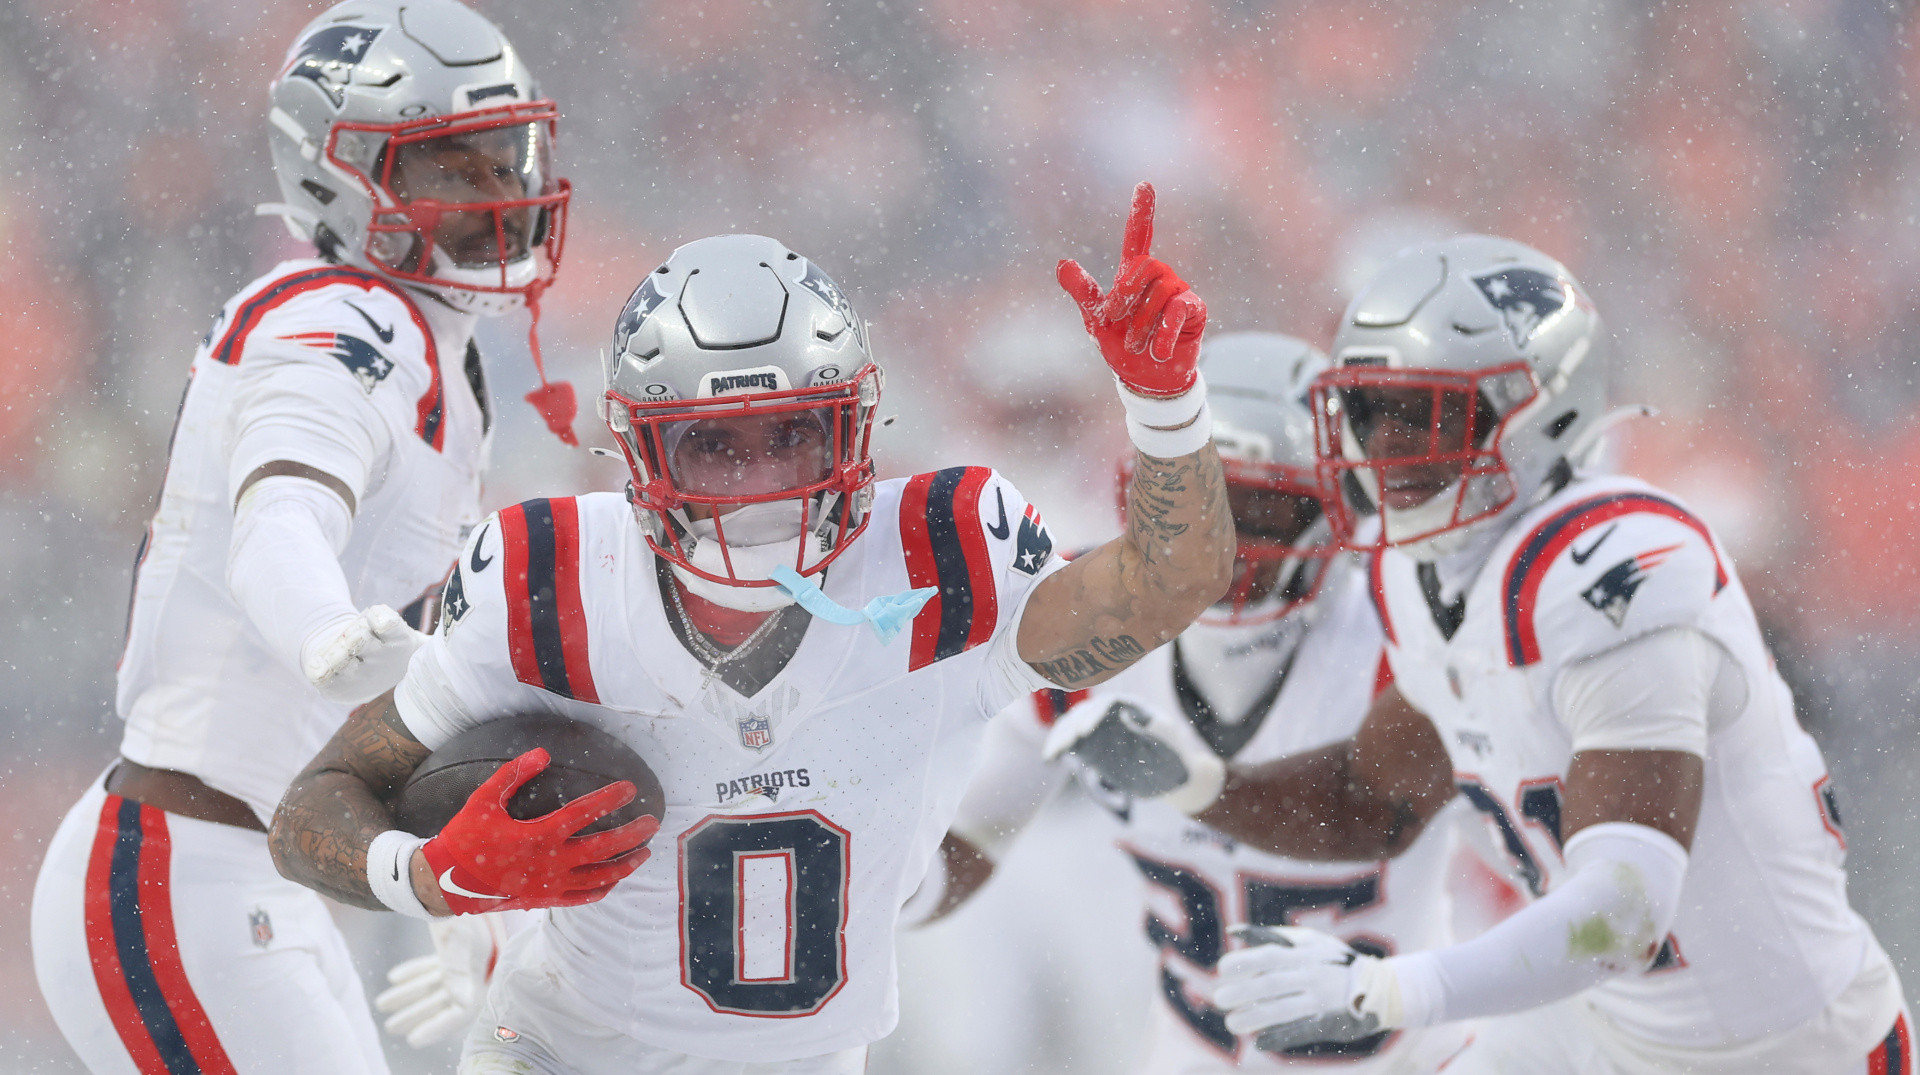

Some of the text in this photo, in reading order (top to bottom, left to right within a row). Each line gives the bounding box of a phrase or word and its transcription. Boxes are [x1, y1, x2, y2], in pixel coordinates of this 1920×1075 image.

[711, 373, 777, 396] PATRIOTS
[744, 730, 769, 746] NFL
[716, 768, 810, 803] PATRIOTS
[677, 809, 851, 1019] 0
